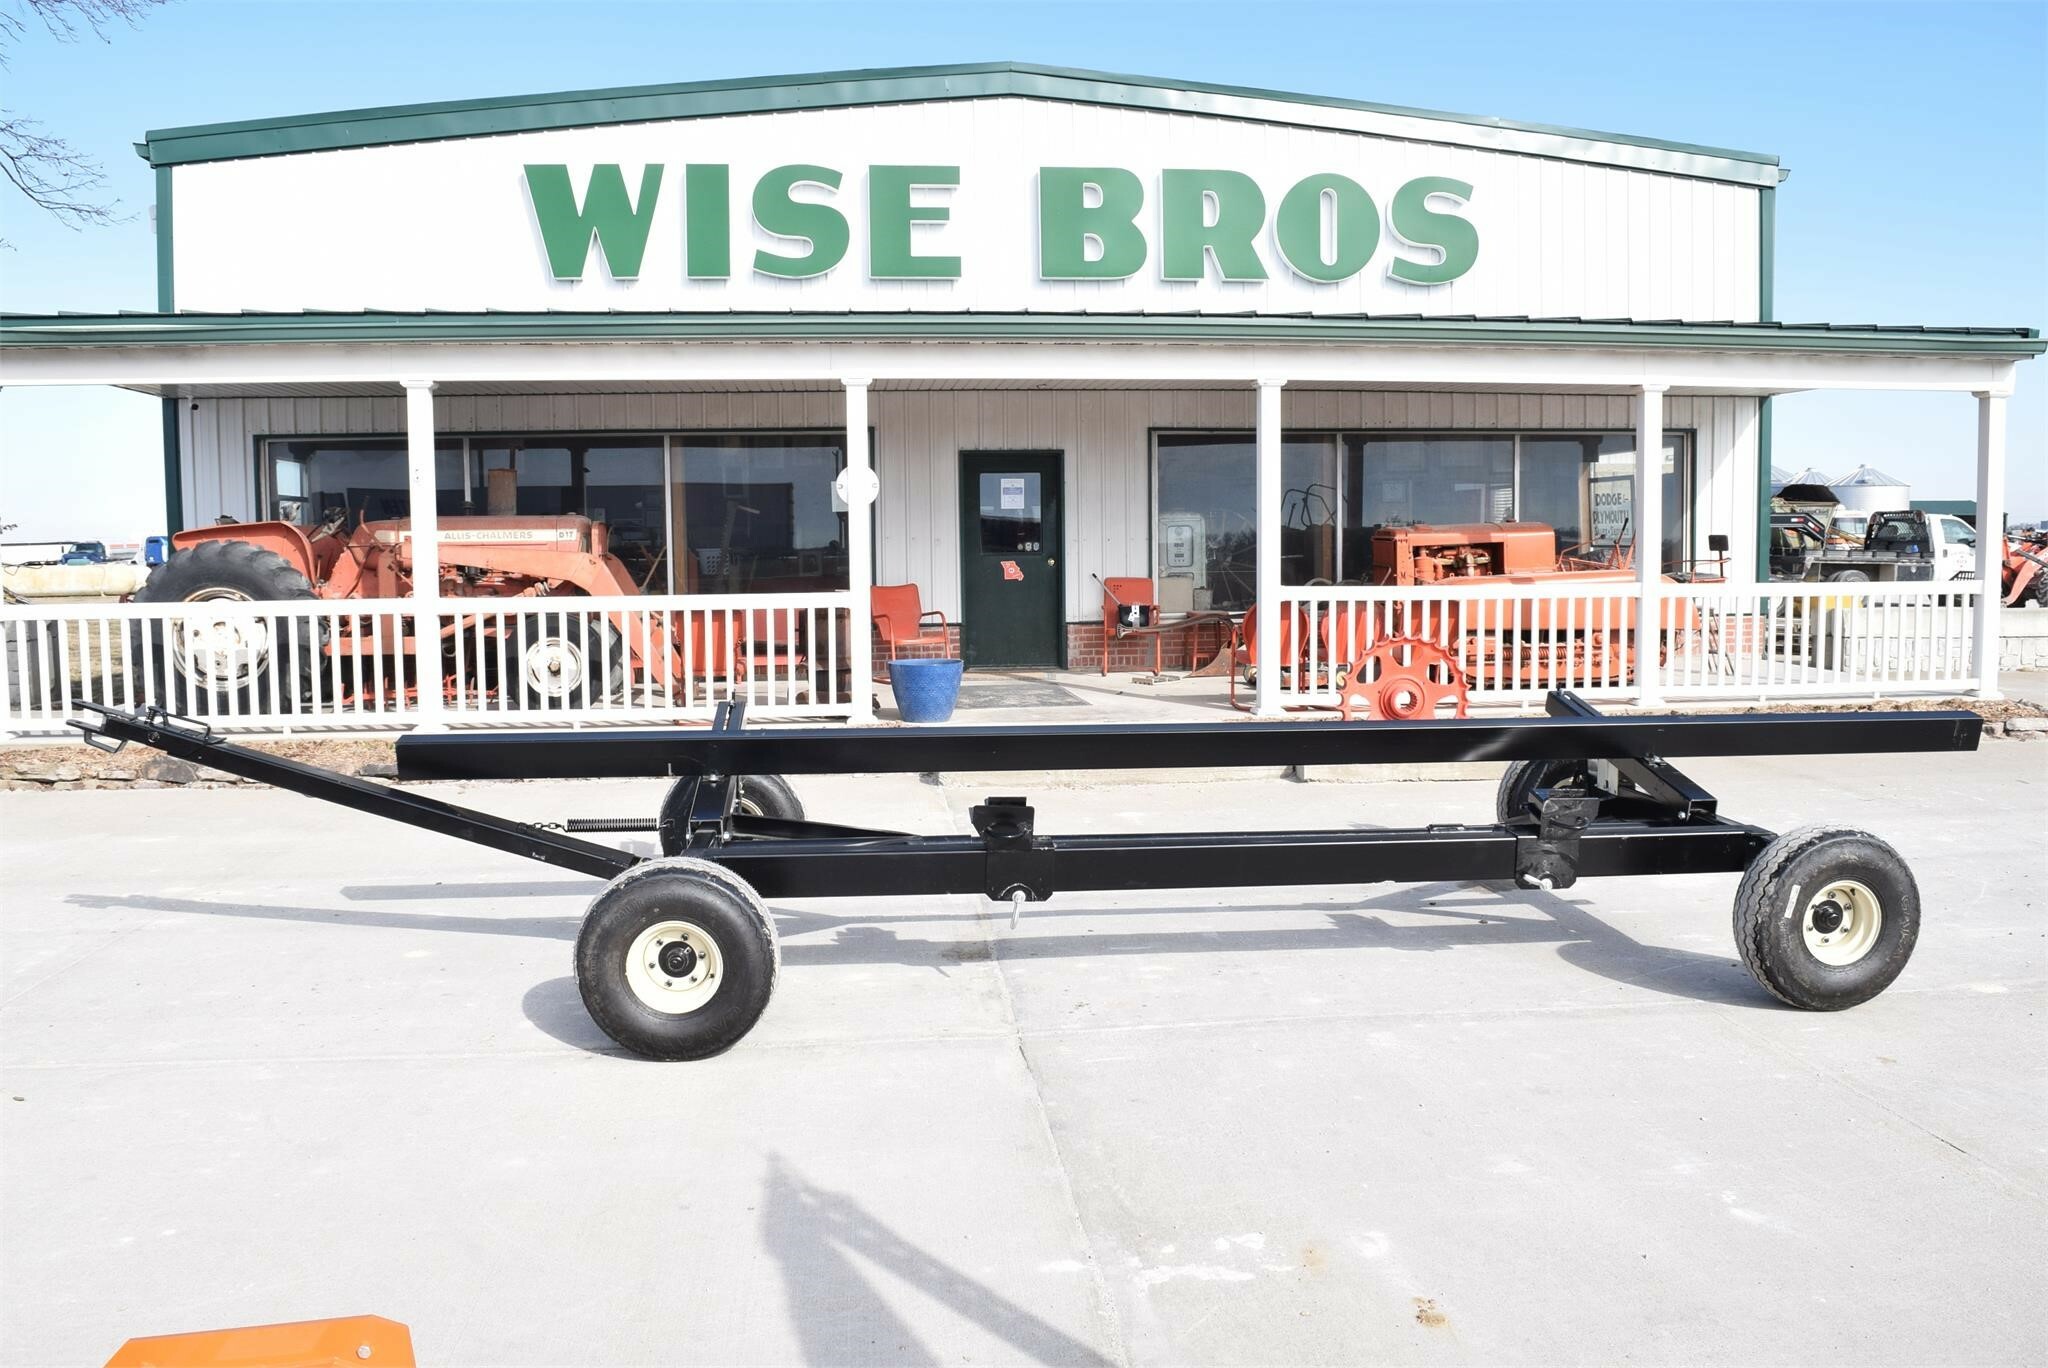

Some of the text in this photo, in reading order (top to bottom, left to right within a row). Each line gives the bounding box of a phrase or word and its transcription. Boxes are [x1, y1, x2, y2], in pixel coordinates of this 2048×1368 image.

[524, 164, 1477, 284] WISE BROS
[444, 531, 533, 540] ALLIS-CHALMERS
